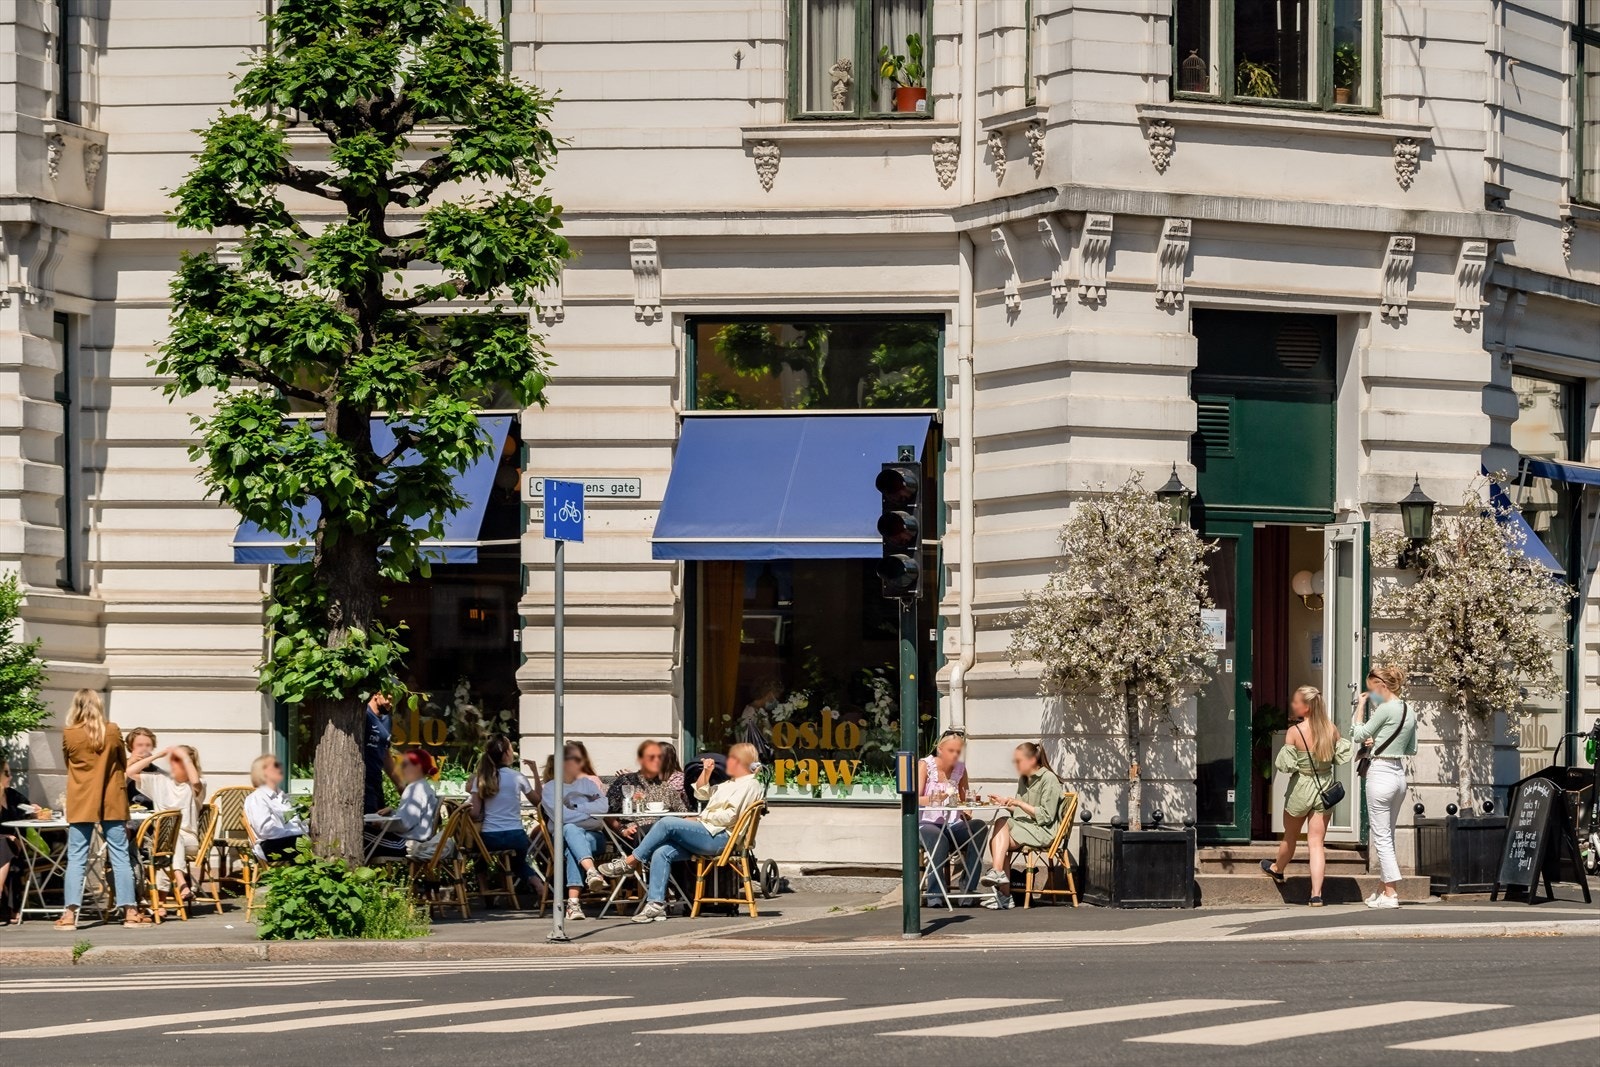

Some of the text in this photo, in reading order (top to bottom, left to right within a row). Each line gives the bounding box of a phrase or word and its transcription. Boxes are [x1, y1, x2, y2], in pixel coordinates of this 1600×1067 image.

[611, 483, 635, 494] gate
[391, 708, 448, 747] slo
[772, 709, 860, 750] oslo
[773, 758, 861, 786] raw
